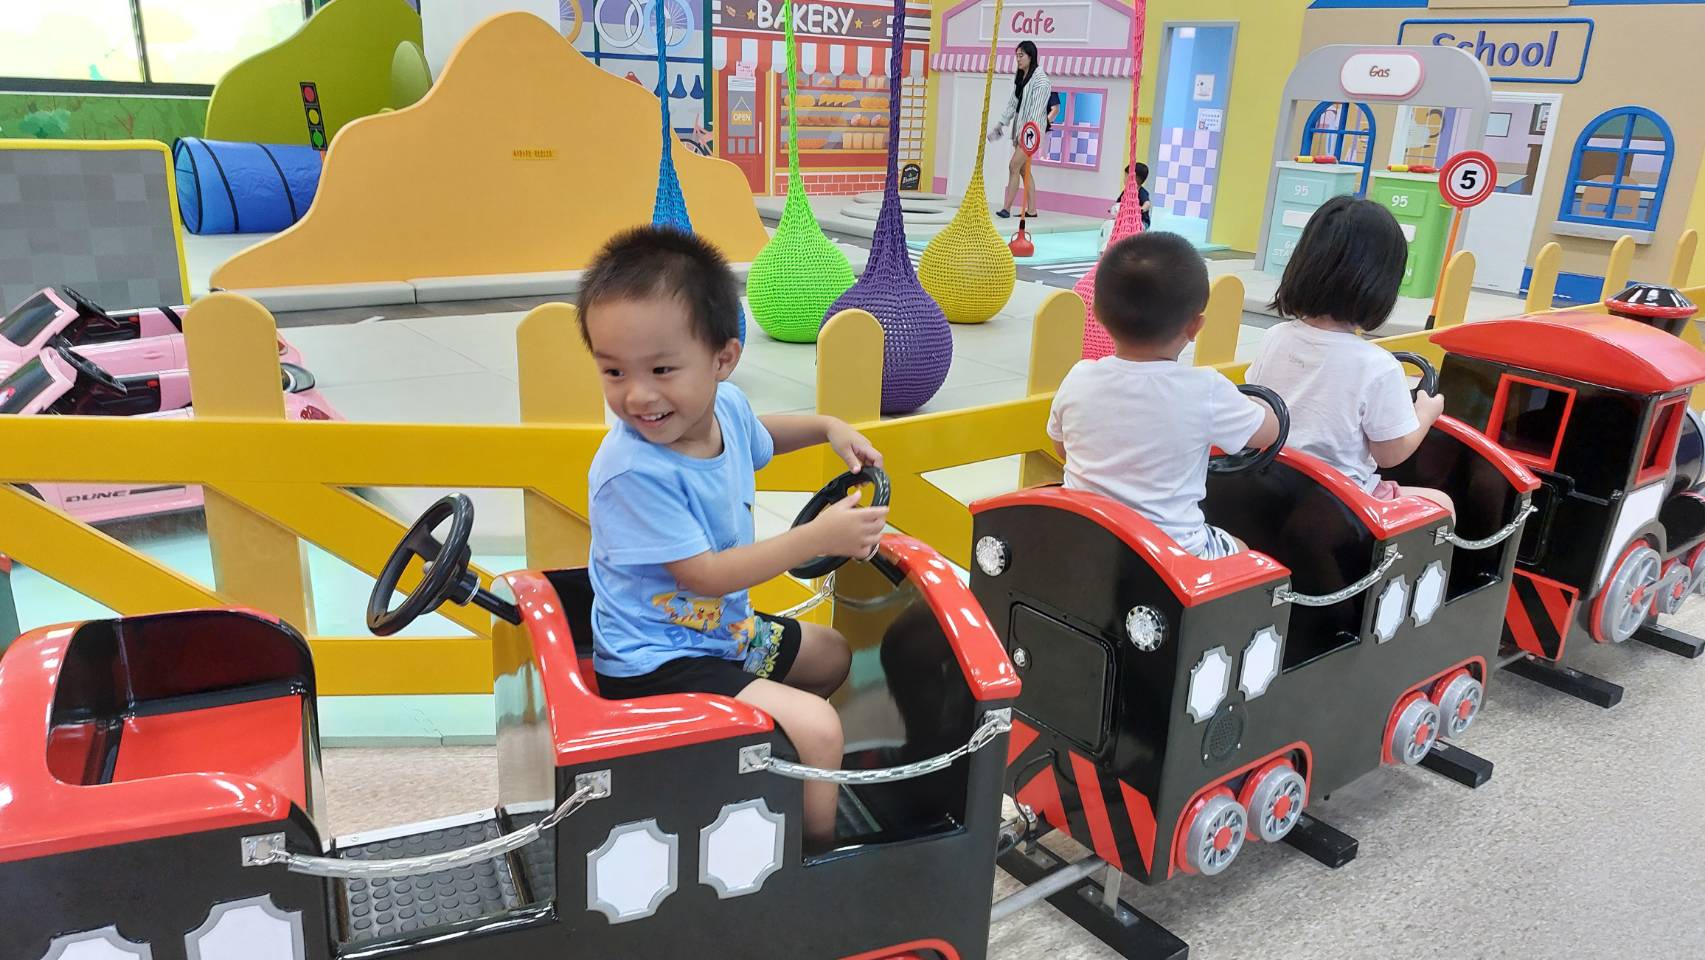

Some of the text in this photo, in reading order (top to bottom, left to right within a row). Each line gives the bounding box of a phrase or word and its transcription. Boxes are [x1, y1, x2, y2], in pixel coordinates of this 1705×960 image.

[757, 0, 855, 35] BAKERY
[1011, 9, 1055, 36] Cafe
[1369, 65, 1390, 78] Gas
[732, 113, 752, 122] OPEN
[1459, 169, 1478, 190] 5
[1294, 184, 1310, 197] 95
[1391, 195, 1409, 208] 95
